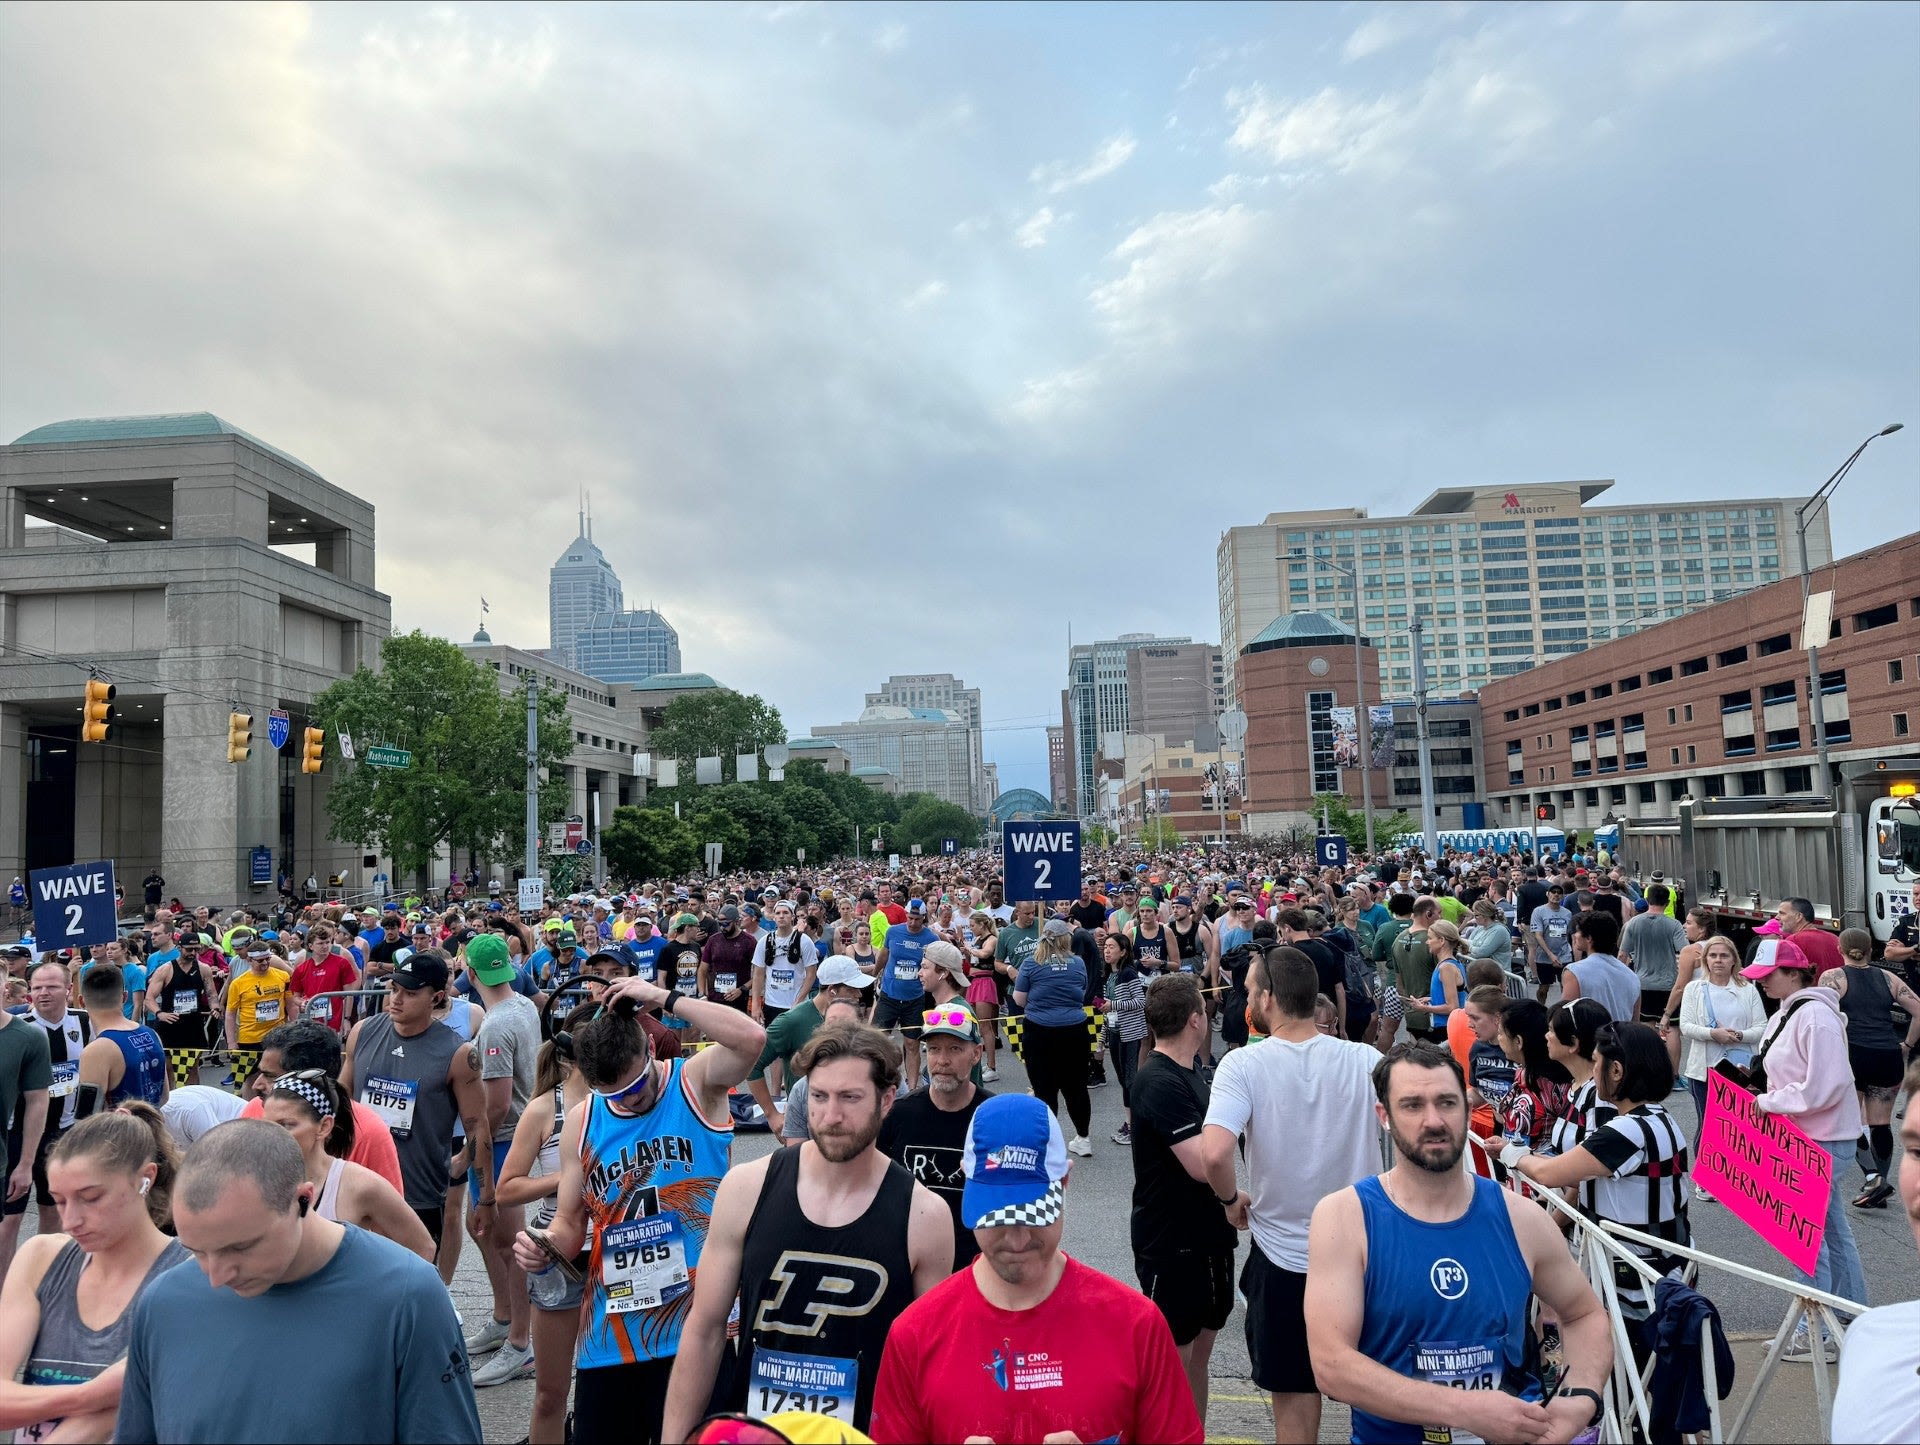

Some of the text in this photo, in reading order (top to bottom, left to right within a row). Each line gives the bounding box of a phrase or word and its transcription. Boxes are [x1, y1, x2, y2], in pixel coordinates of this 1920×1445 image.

[1505, 506, 1556, 514] MARRIOTT
[1145, 649, 1178, 658] WESTIN
[270, 720, 288, 732] 65 70
[368, 751, 408, 764] Washington St
[946, 841, 954, 852] H
[1011, 832, 1074, 853] WAVE
[1326, 842, 1338, 860] G
[1034, 859, 1052, 889] 2
[38, 872, 106, 901] WAVE
[64, 904, 84, 936] 2
[368, 1092, 407, 1110] 18175
[1712, 1076, 1744, 1121] YOU
[1778, 1124, 1829, 1184] BETTER
[1004, 1150, 1038, 1165] MINI
[1716, 1117, 1803, 1194] THAN THE
[912, 1154, 927, 1180] R
[1001, 1162, 1036, 1171] MARATHON
[1701, 1143, 1822, 1248] GOVERNMENT
[606, 1222, 674, 1247] MINI-MARATHON
[613, 1240, 671, 1270] 9765
[629, 1264, 660, 1276] PAYTON
[753, 1250, 889, 1337] P
[617, 1302, 632, 1310] No.
[633, 1296, 656, 1307] 9765
[1028, 1352, 1048, 1362] CNO
[758, 1362, 846, 1386] MINI-MARATHON
[1014, 1366, 1062, 1374] INDIANAPOLIS
[1014, 1372, 1062, 1384] MONUMENTAL
[1030, 1380, 1063, 1390] MARATHON
[760, 1386, 840, 1418] 17312
